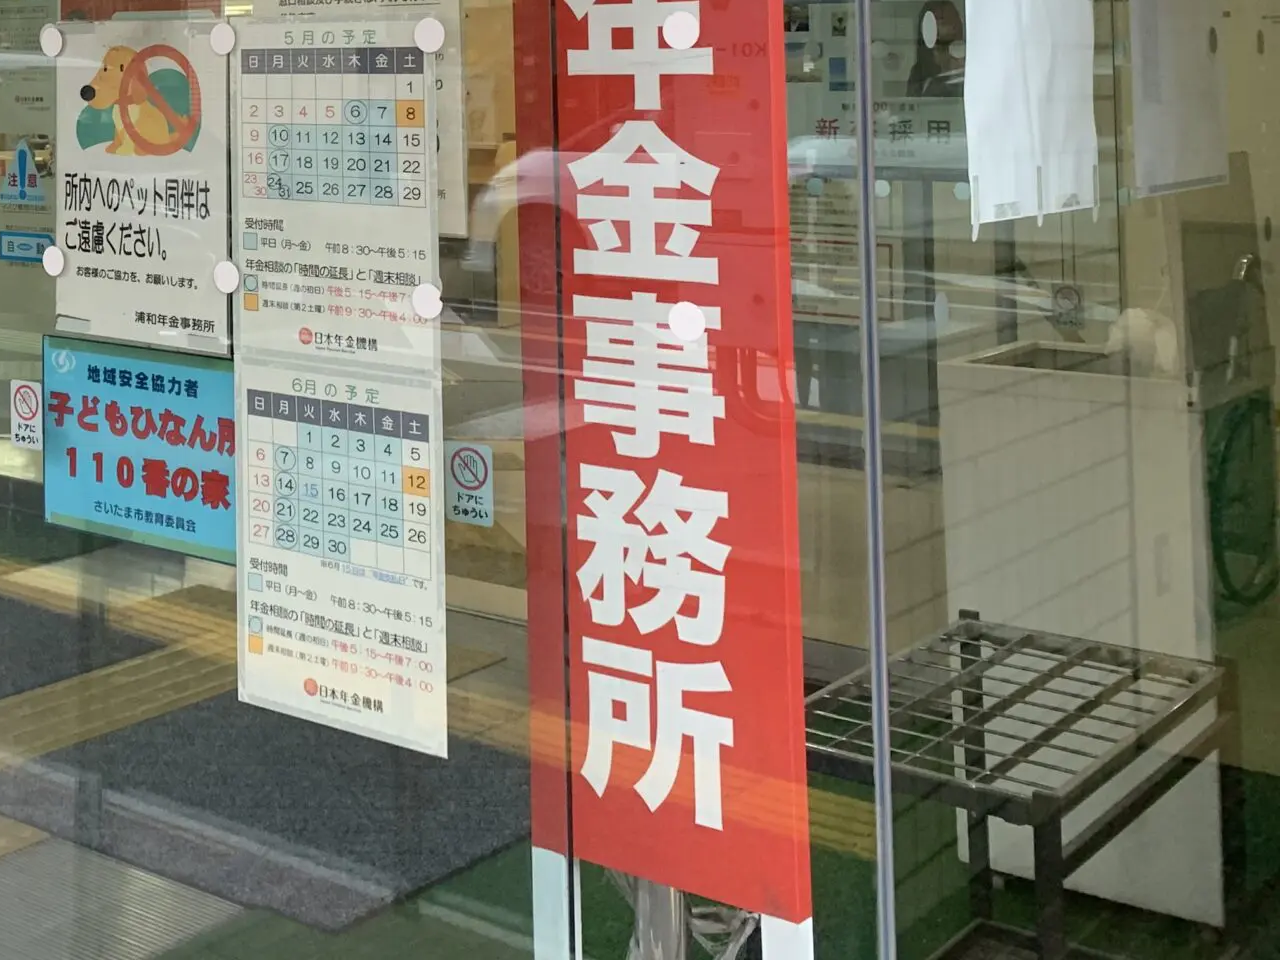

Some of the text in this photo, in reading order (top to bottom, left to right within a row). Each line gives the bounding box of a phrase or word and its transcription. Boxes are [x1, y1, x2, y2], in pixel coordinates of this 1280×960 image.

[249, 54, 416, 68] 日 月 火 水 木 金 土
[408, 82, 413, 93] 1
[250, 105, 416, 120] 2 3 4 5 6 7 8
[250, 130, 420, 146] 9 10 11 12 13 14 15
[248, 153, 420, 173] 16 17 18 19 20 21 22
[65, 173, 210, 220] 所内へのペット同伴は
[245, 174, 257, 183] 23
[296, 182, 313, 194] 25
[323, 183, 339, 195] 26
[348, 184, 366, 196] 27
[375, 186, 393, 198] 28
[403, 187, 420, 199] 29
[255, 187, 266, 196] 30
[245, 218, 284, 231] 受付時間
[65, 218, 166, 261] ご遠慮ください。
[135, 311, 215, 333] 浦和年金事務所
[314, 332, 377, 351] 日本年金機構
[88, 365, 198, 398] 地域安全協力者
[255, 397, 421, 434] 日 月 火 水 木 金 土
[15, 433, 39, 444] ちゅうい
[17, 422, 36, 433] ドアに
[307, 432, 420, 460] 1 2 3 4 5
[66, 447, 232, 511] 110番の家
[257, 449, 425, 489] 6 7 8 9 10 11 12
[253, 473, 426, 516] 13 14 15 16 17 18 19
[456, 493, 483, 505] ドアに
[94, 500, 196, 533] さいたま市教育委員会
[253, 500, 426, 544] 20 21 22 23 24 25 26
[452, 504, 488, 519] ちゅうい
[253, 525, 346, 554] 27 28 29 30
[250, 558, 287, 576] 受付時間
[320, 685, 383, 713] 日本年金機構
